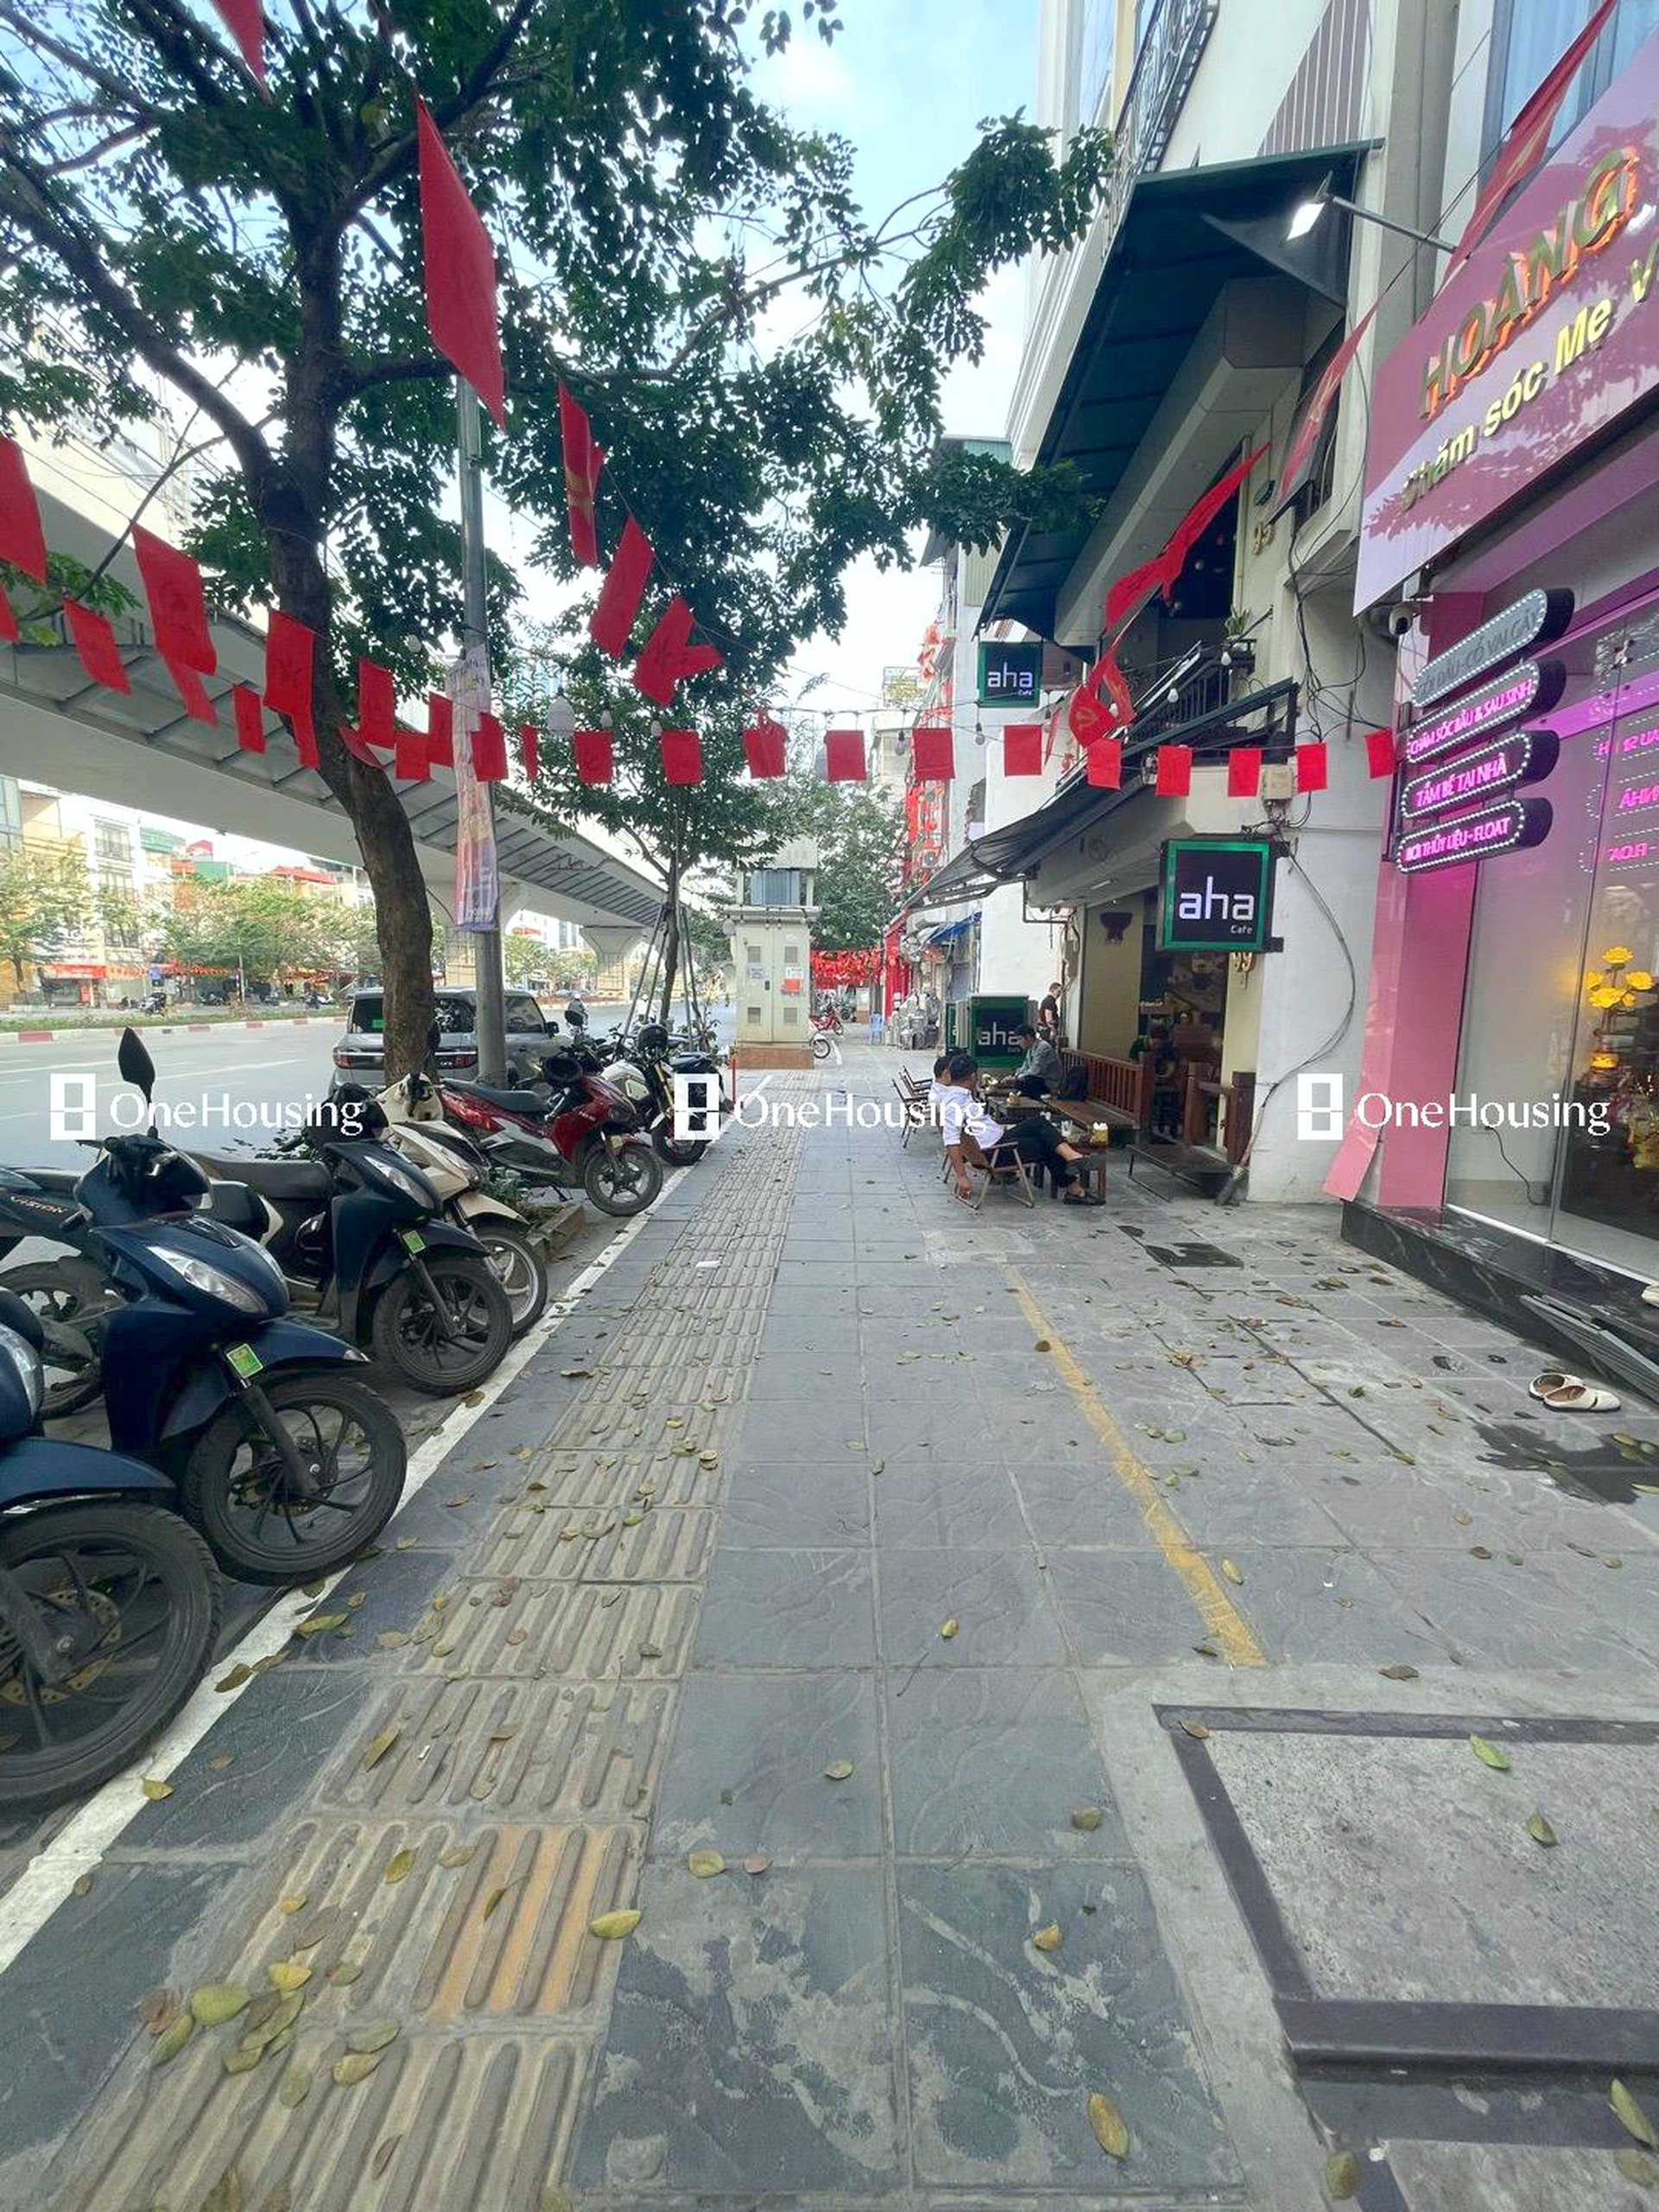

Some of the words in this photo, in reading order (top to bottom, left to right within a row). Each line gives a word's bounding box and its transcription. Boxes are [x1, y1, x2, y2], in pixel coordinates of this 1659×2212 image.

[1482, 364, 1549, 440] sóc
[1554, 295, 1617, 377] Mẹ
[987, 662, 1034, 688] aha
[1483, 694, 1507, 719] SAU
[1504, 678, 1533, 707] SINH
[1475, 751, 1508, 784] NHÀ
[1473, 816, 1511, 843] FLOAT
[1179, 876, 1255, 922] aha
[1230, 924, 1253, 935] Cafe
[978, 1021, 1024, 1046] aha
